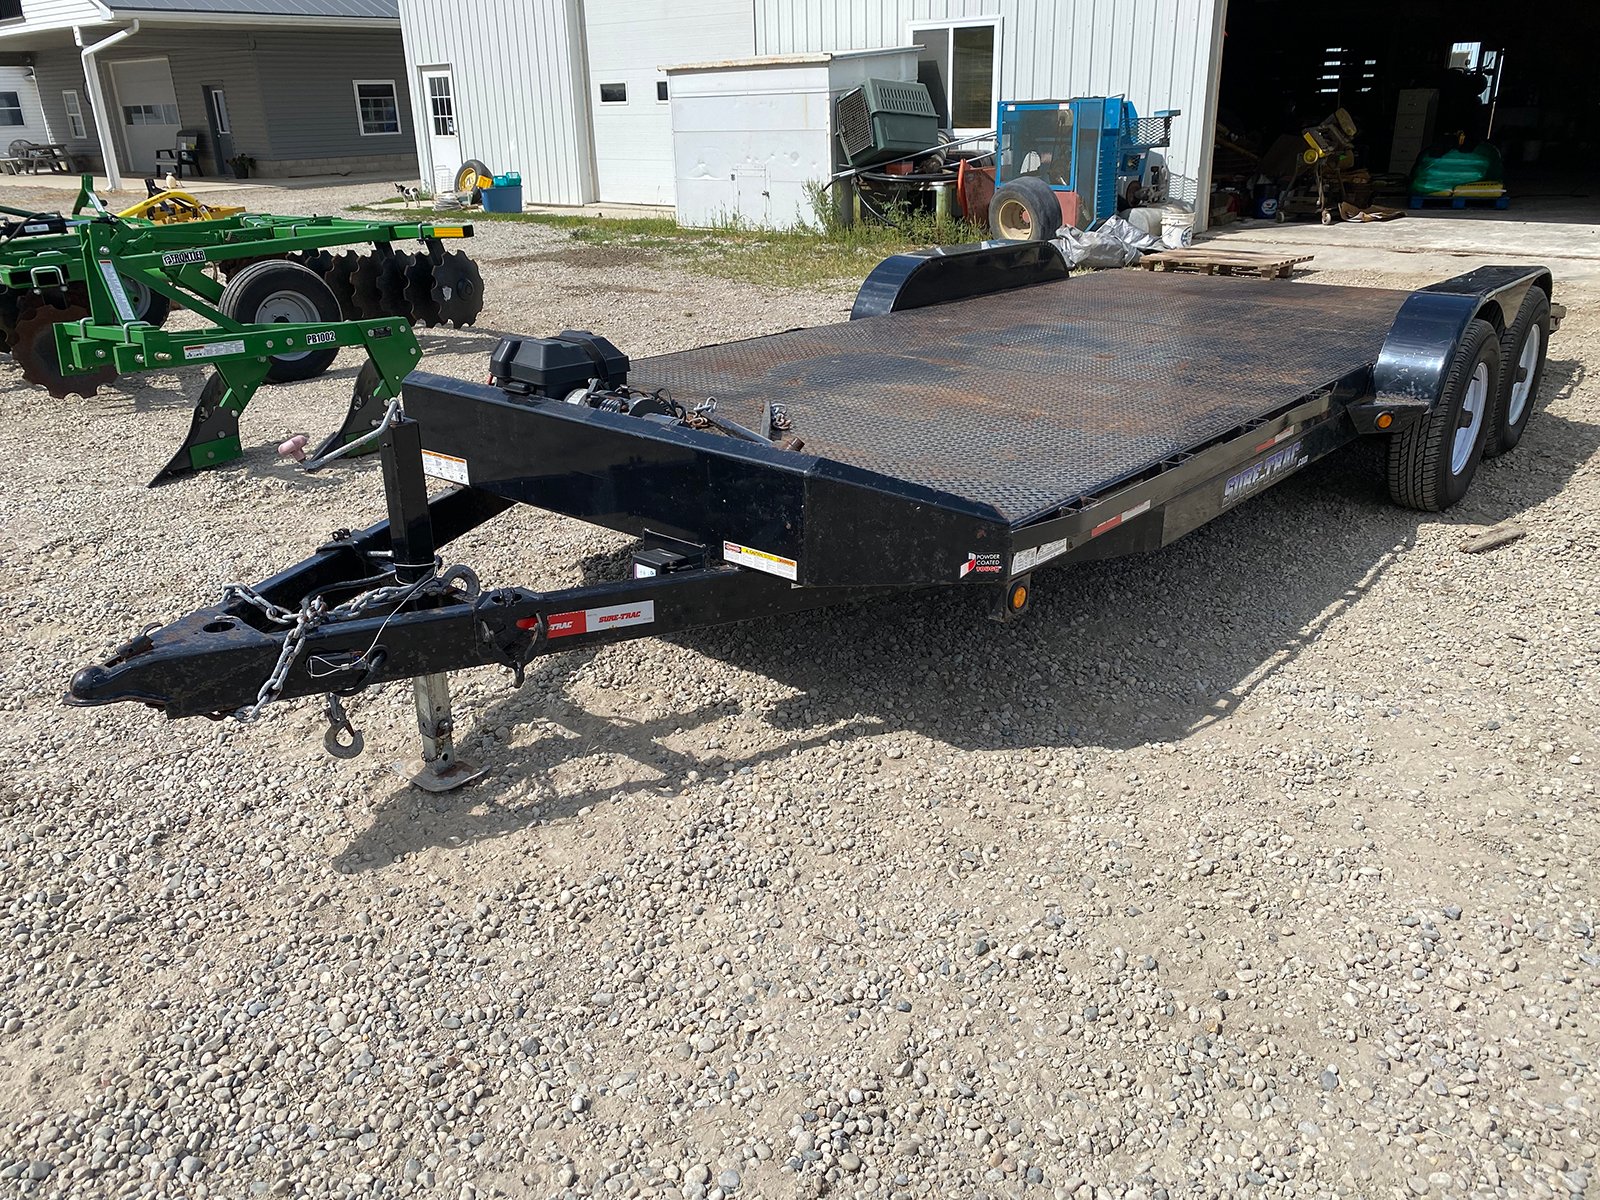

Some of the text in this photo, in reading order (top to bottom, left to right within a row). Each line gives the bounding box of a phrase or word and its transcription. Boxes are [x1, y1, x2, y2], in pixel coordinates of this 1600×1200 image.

[172, 250, 205, 264] FRONTIER
[306, 331, 336, 344] PB1002
[598, 611, 641, 623] SURE-TRAC
